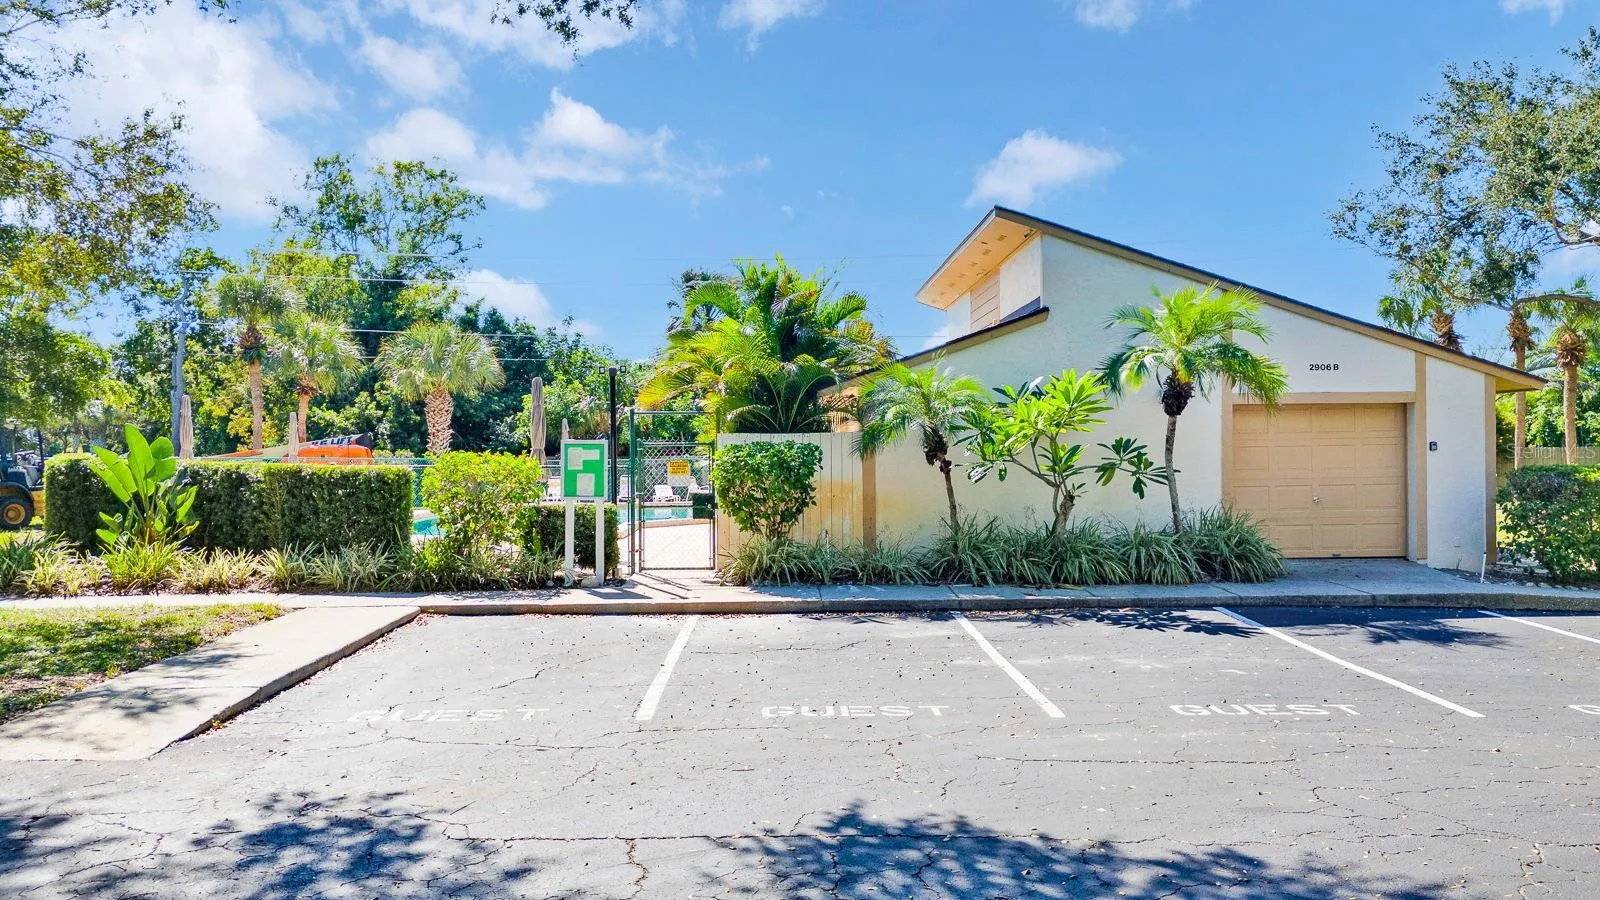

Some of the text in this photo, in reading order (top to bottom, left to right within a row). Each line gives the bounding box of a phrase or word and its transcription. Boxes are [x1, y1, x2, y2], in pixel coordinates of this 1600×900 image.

[1309, 363, 1339, 371] 2906 B
[330, 436, 352, 446] LIFT
[346, 708, 550, 722] GUEST
[761, 705, 950, 718] GUEST
[1169, 704, 1360, 716] GUEST
